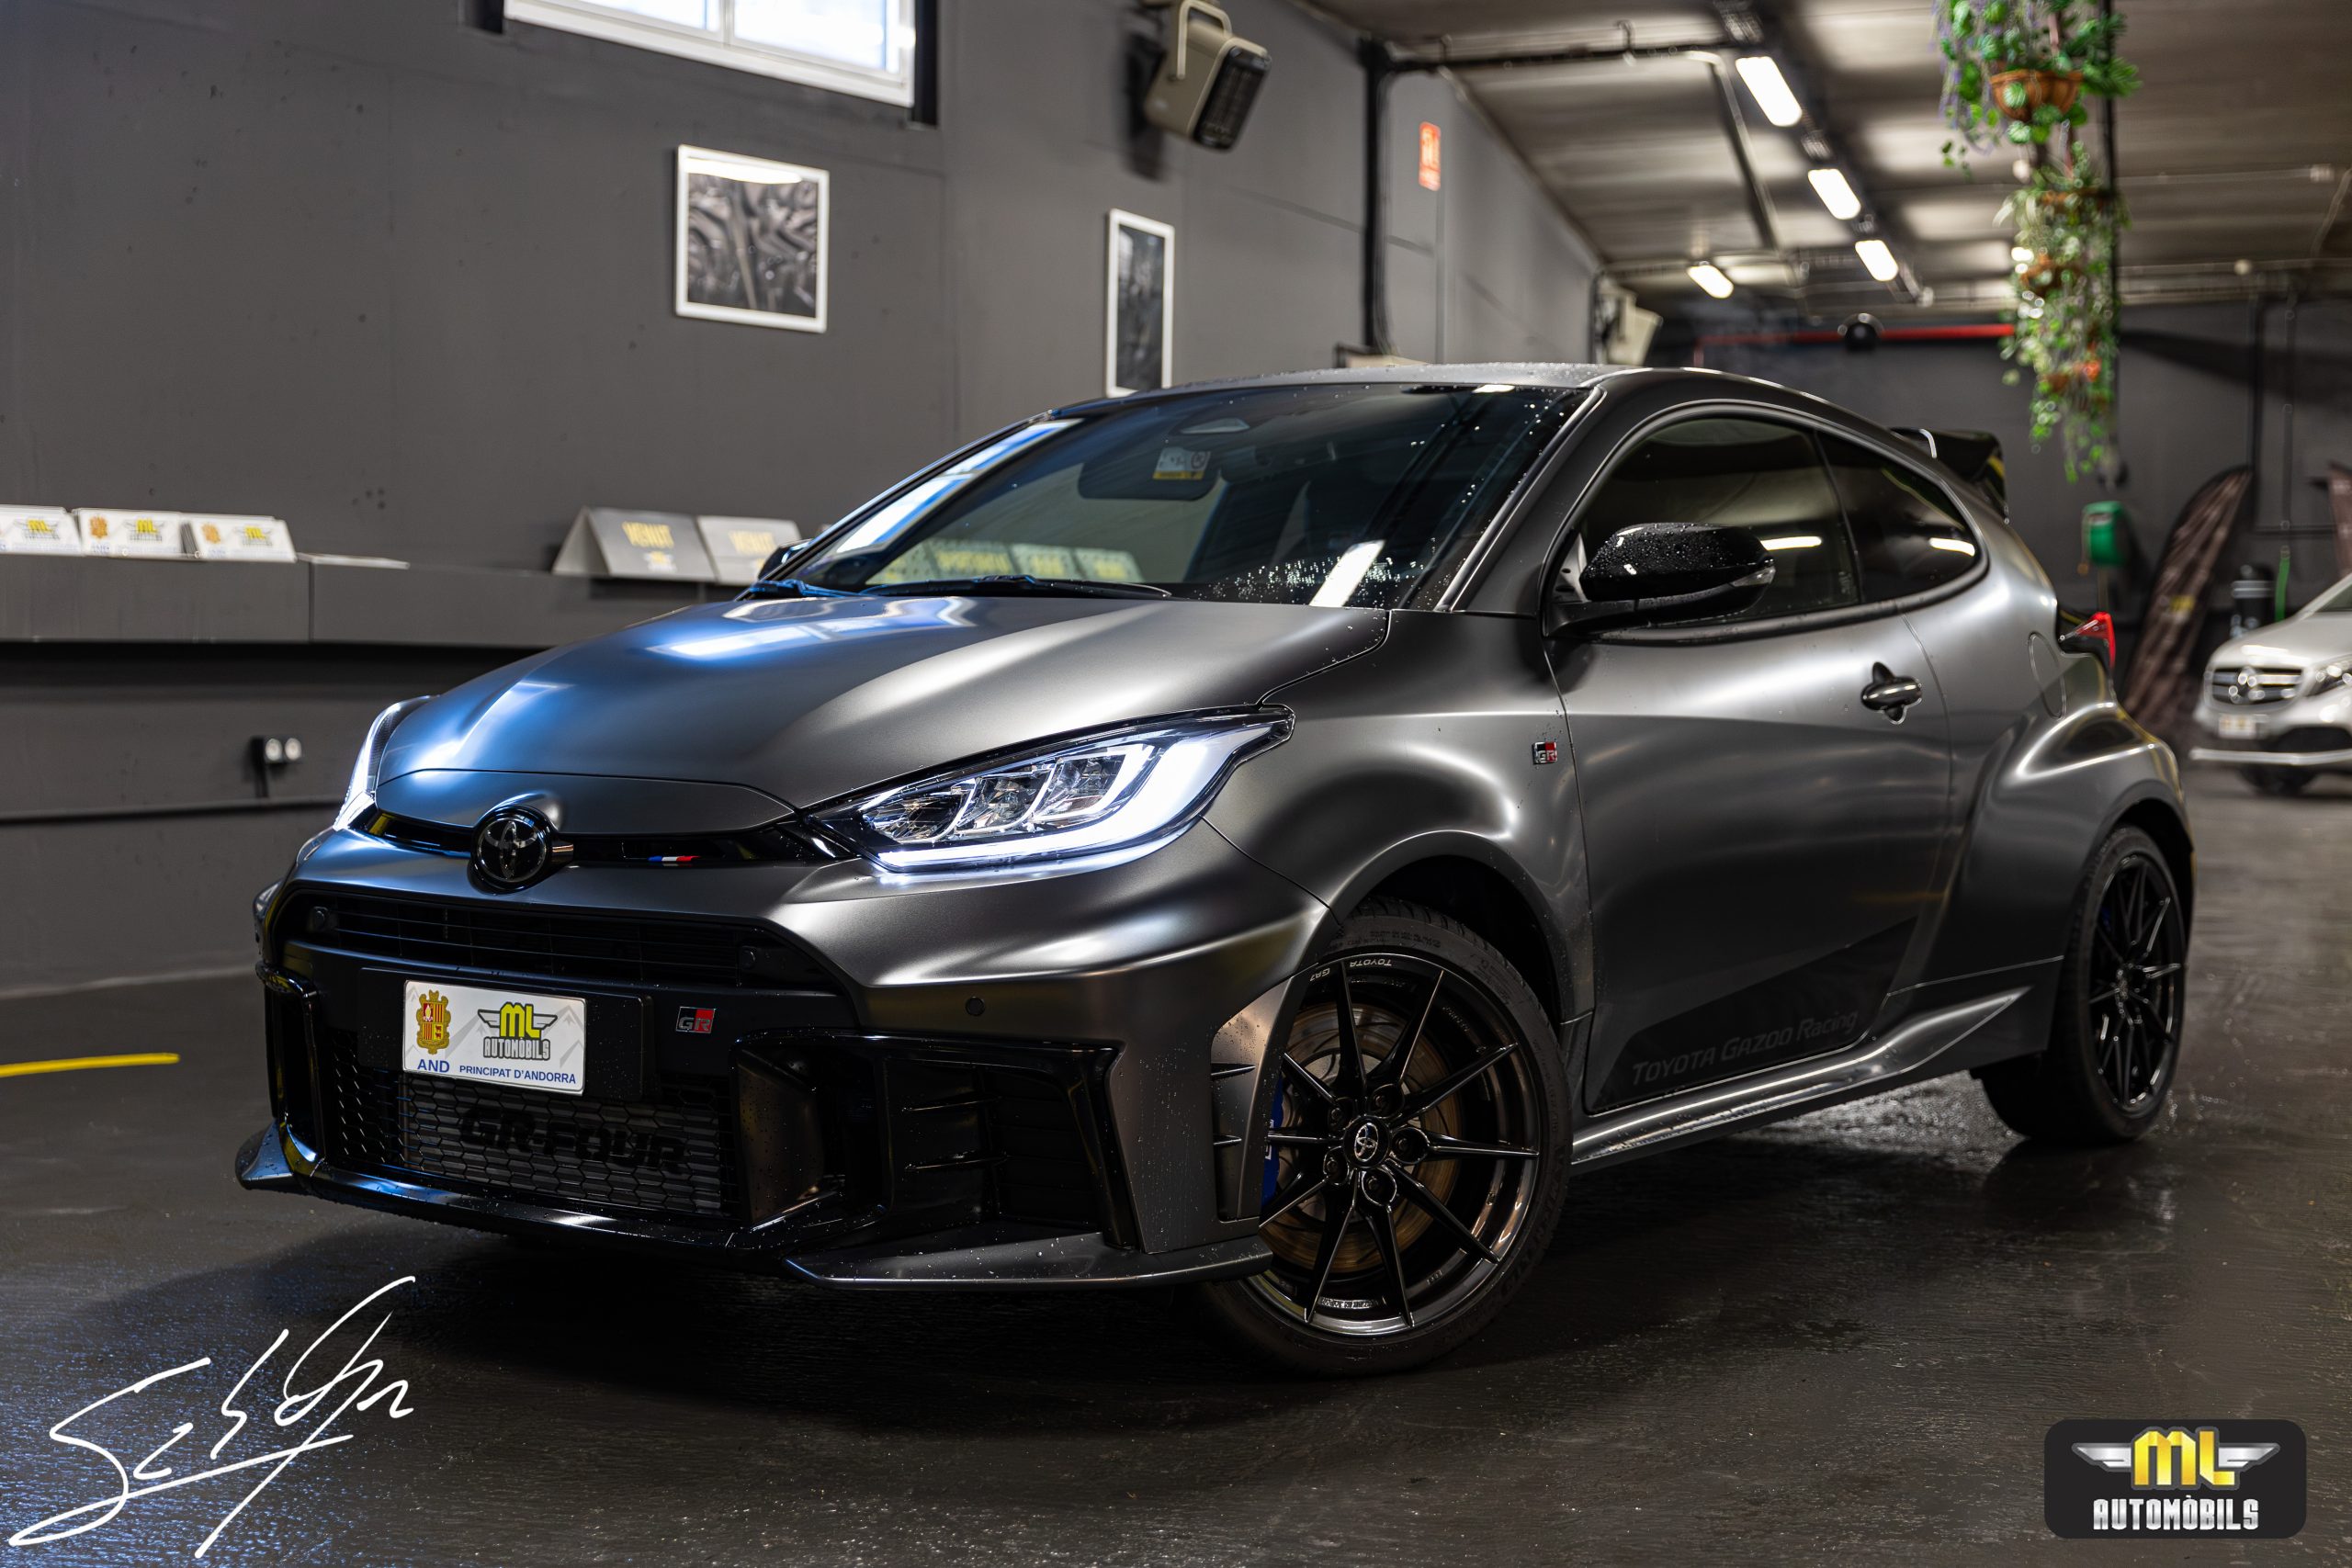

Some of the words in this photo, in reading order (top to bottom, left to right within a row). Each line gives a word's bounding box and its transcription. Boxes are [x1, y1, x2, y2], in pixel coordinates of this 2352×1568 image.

[1535, 750, 1557, 763] GR
[1349, 957, 1394, 968] TOYOTA
[499, 1002, 542, 1039] ML
[678, 1016, 711, 1032] GR
[1632, 1046, 1715, 1086] TOYOTA
[1720, 1026, 1793, 1062] GAZOO
[1796, 1011, 1859, 1043] Racing
[416, 1058, 451, 1074] AND
[458, 1065, 511, 1079] PRINCIPAT
[513, 1069, 577, 1086] D'ANDORRA
[461, 1106, 687, 1176] GR-FOUR
